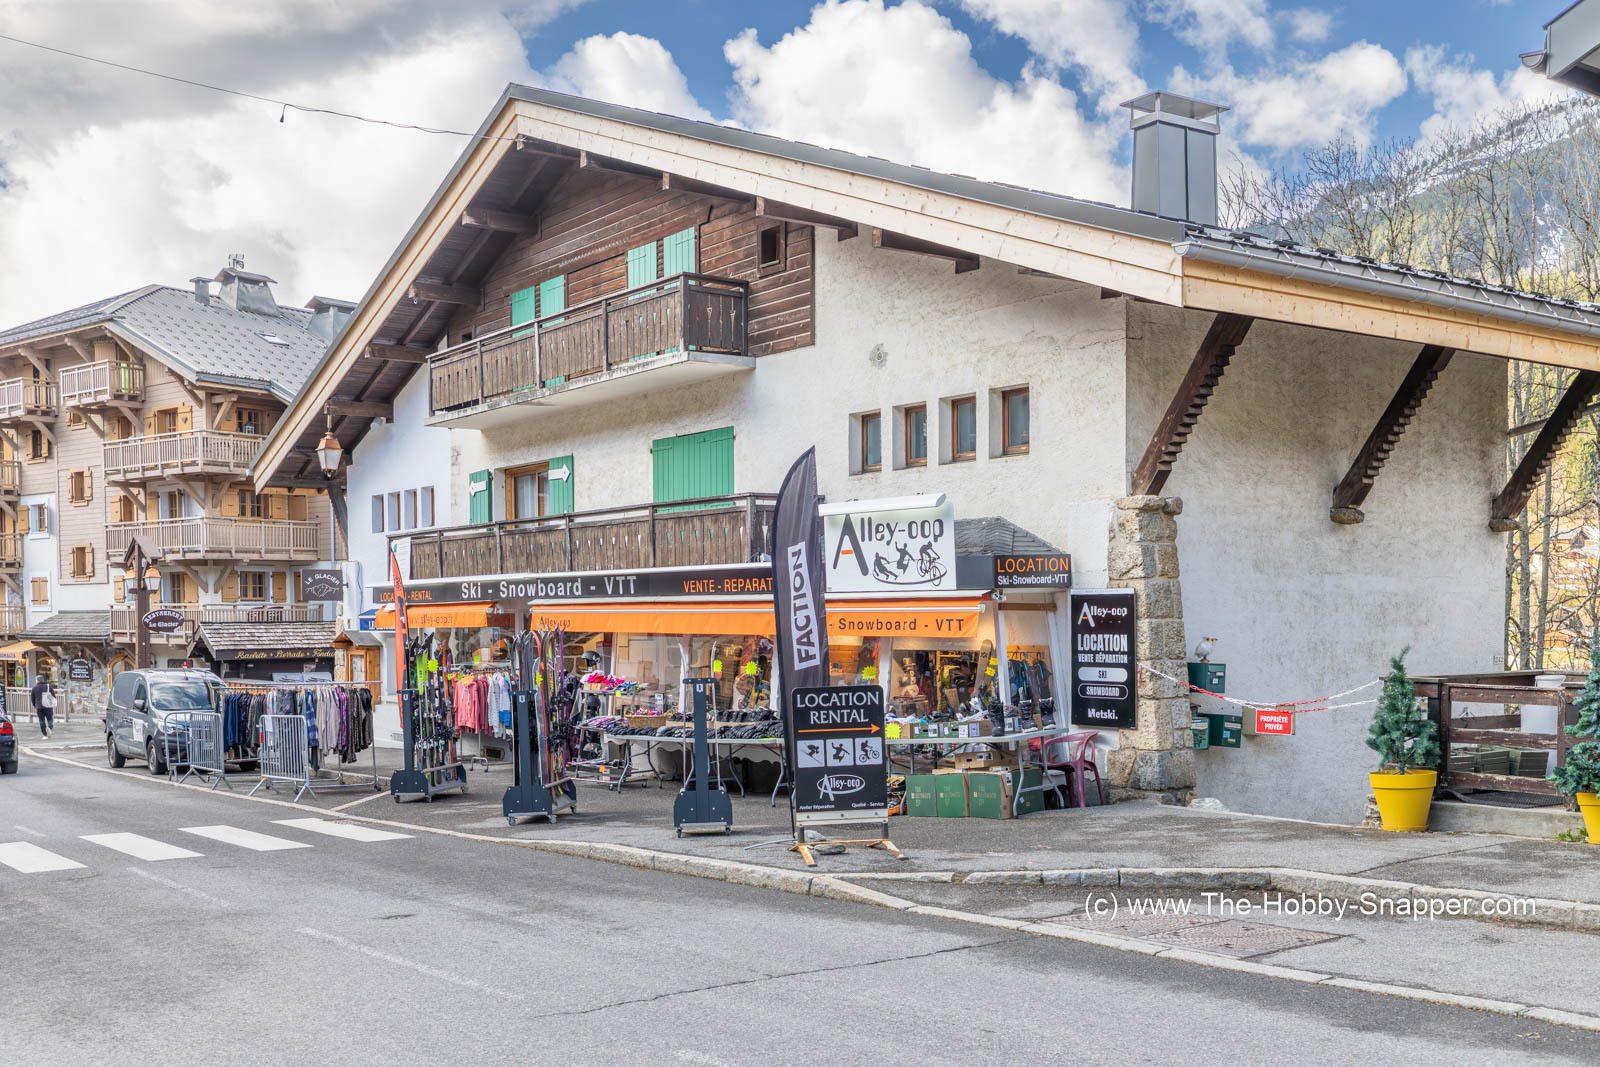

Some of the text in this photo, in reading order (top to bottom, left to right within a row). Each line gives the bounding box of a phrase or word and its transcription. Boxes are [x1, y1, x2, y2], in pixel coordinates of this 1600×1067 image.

[833, 513, 944, 577] Alley-oop
[997, 557, 1069, 572] LOCATION
[305, 573, 340, 585] LE GLACIER
[683, 579, 715, 593] VENTE
[461, 582, 481, 599] Ski
[500, 578, 582, 598] Snowboard
[604, 575, 637, 595] VTT
[411, 590, 433, 601] RENTAL
[791, 549, 817, 664] FACTION
[144, 610, 185, 623] RESTAURANT
[1078, 602, 1128, 627] Alley-oop
[838, 618, 917, 631] Snowboard
[936, 619, 965, 631] VTT
[1077, 634, 1128, 651] LOCATION
[1078, 653, 1095, 662] VENTE
[1098, 670, 1107, 679] SKI
[1086, 686, 1120, 697] SNOWBOARD
[796, 691, 879, 708] LOCATION
[810, 709, 869, 724] RENTAL
[1260, 714, 1289, 724] PROPRIÉTÉ
[1264, 722, 1284, 731] PRIVÉE
[820, 774, 861, 802] Alley-oop
